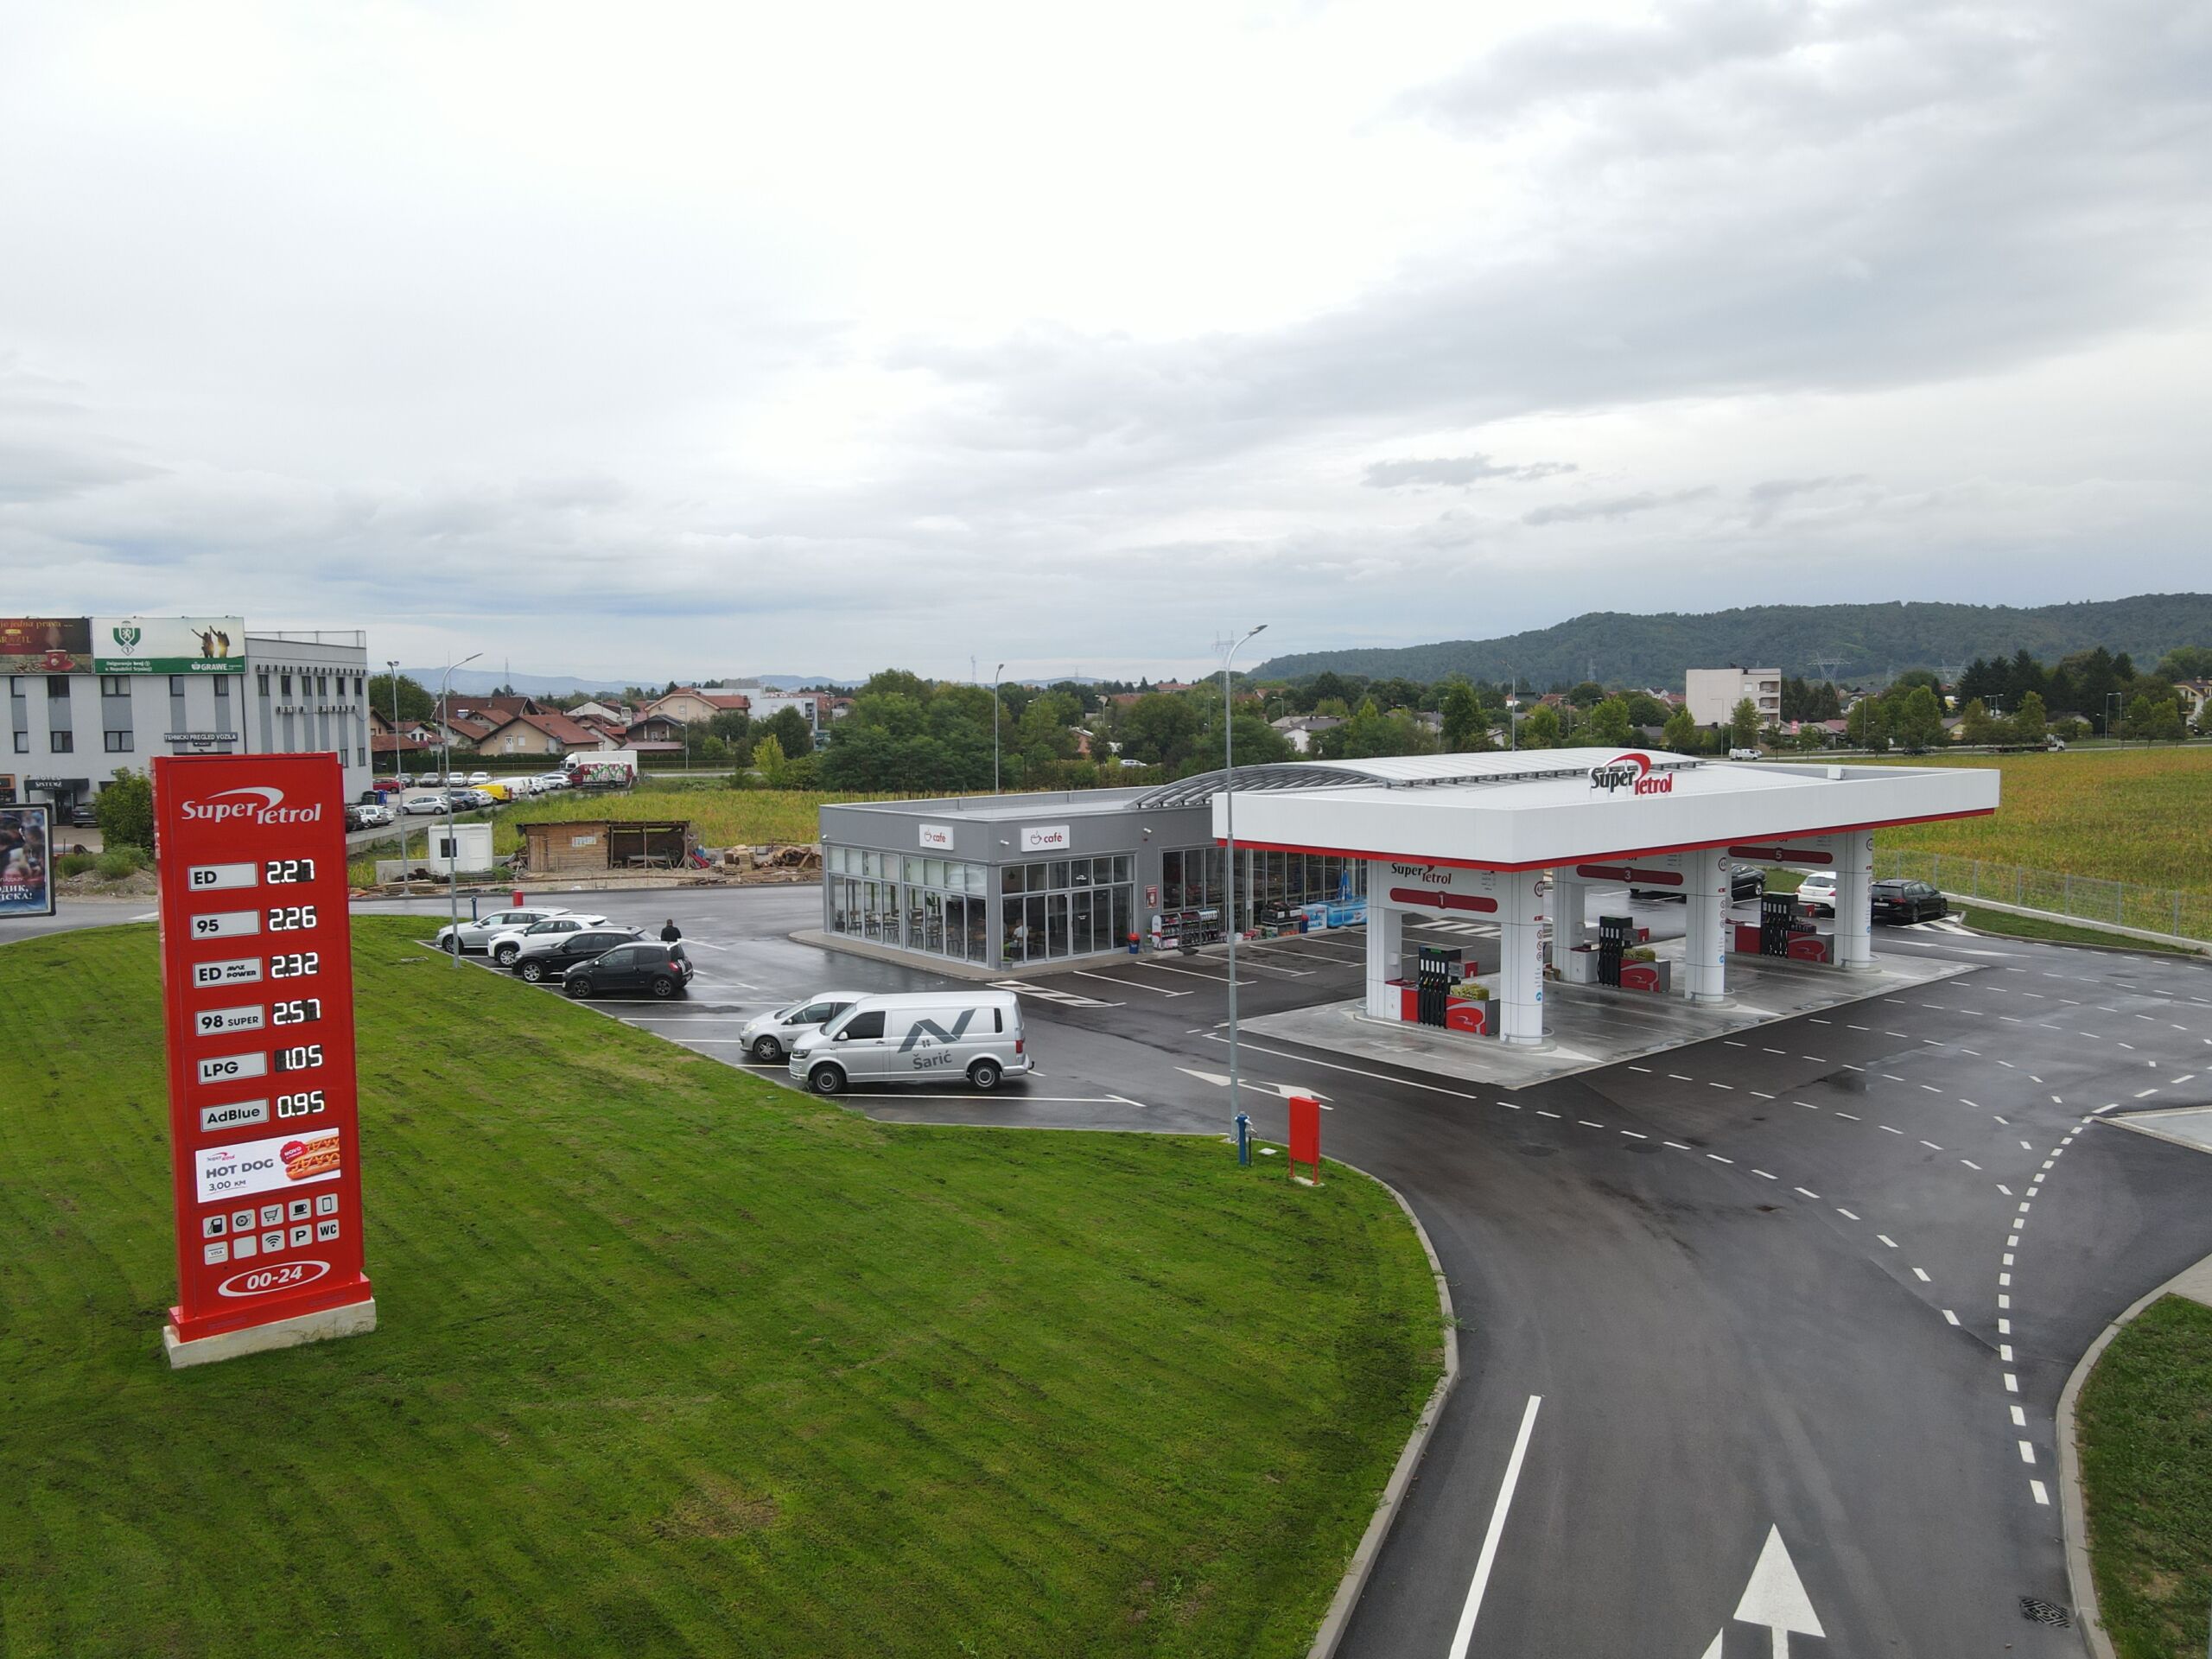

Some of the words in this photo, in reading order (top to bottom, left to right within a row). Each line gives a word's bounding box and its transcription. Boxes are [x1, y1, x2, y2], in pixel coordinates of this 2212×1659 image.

[200, 663, 228, 671] GRAWE
[1590, 767, 1636, 793] Super
[181, 800, 257, 823] Super
[932, 833, 946, 843] café
[1043, 831, 1063, 843] café
[1775, 849, 1783, 860] 5
[194, 871, 217, 885] ED
[267, 859, 315, 884] 2.27
[1391, 862, 1423, 877] Super
[1624, 869, 1632, 880] 3
[197, 919, 219, 933] 95
[269, 906, 317, 931] 2.26
[271, 952, 319, 978] 2.32
[199, 967, 222, 982] ED
[226, 970, 257, 979] POWER
[201, 1015, 224, 1029] 98
[228, 1016, 259, 1027] SUPER
[273, 999, 321, 1026] 2.57
[204, 1061, 239, 1077] LPG
[285, 1045, 323, 1070] 1.05
[912, 1050, 952, 1070] Šarić
[207, 1108, 260, 1124] AdBlue
[277, 1090, 325, 1118] 0.95
[284, 1146, 302, 1156] NOVO
[206, 1165, 238, 1179] HOT
[241, 1159, 274, 1173] DOG
[208, 1180, 232, 1192] 3,00
[296, 1230, 307, 1243] P
[320, 1224, 337, 1236] WC
[246, 1265, 302, 1290] 00-24
